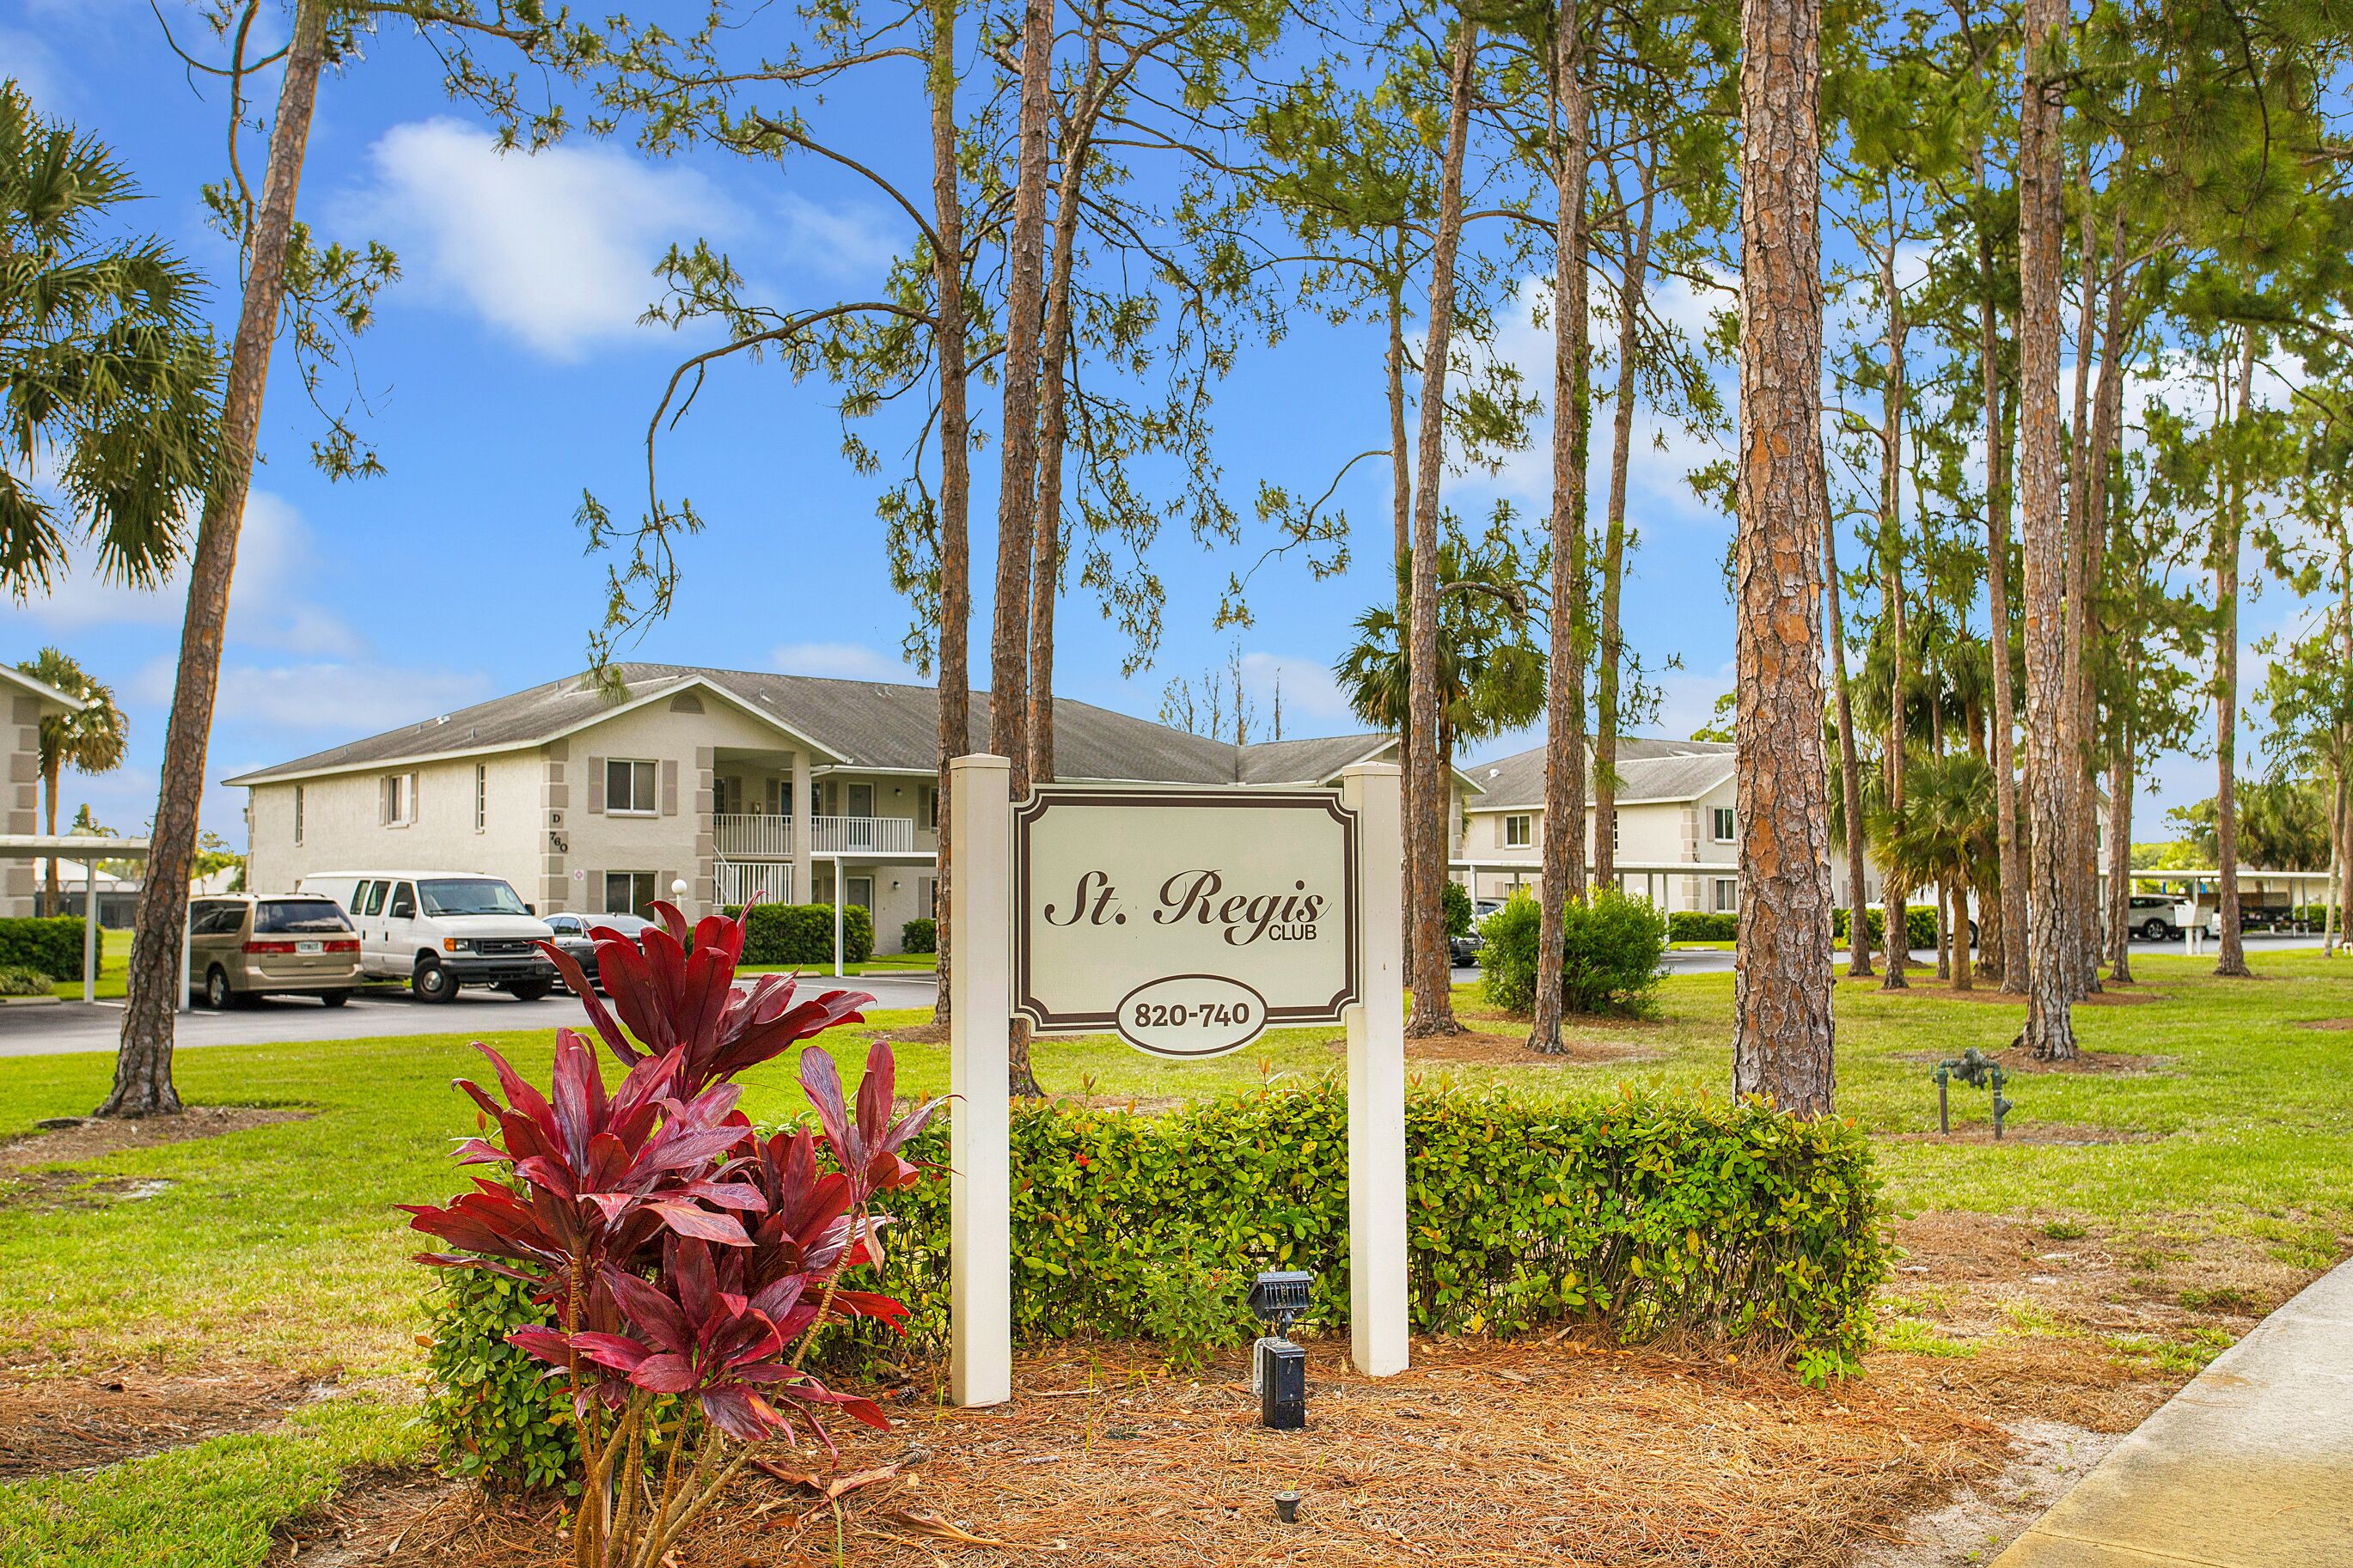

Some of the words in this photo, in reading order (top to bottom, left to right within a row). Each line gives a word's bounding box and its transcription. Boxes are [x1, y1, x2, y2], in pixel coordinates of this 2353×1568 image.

[553, 814, 561, 823] D
[549, 832, 568, 852] 760
[1043, 870, 1128, 926] St.
[1152, 869, 1333, 947] Regis
[1268, 924, 1317, 941] CLUB
[1134, 1003, 1250, 1028] 820-740
